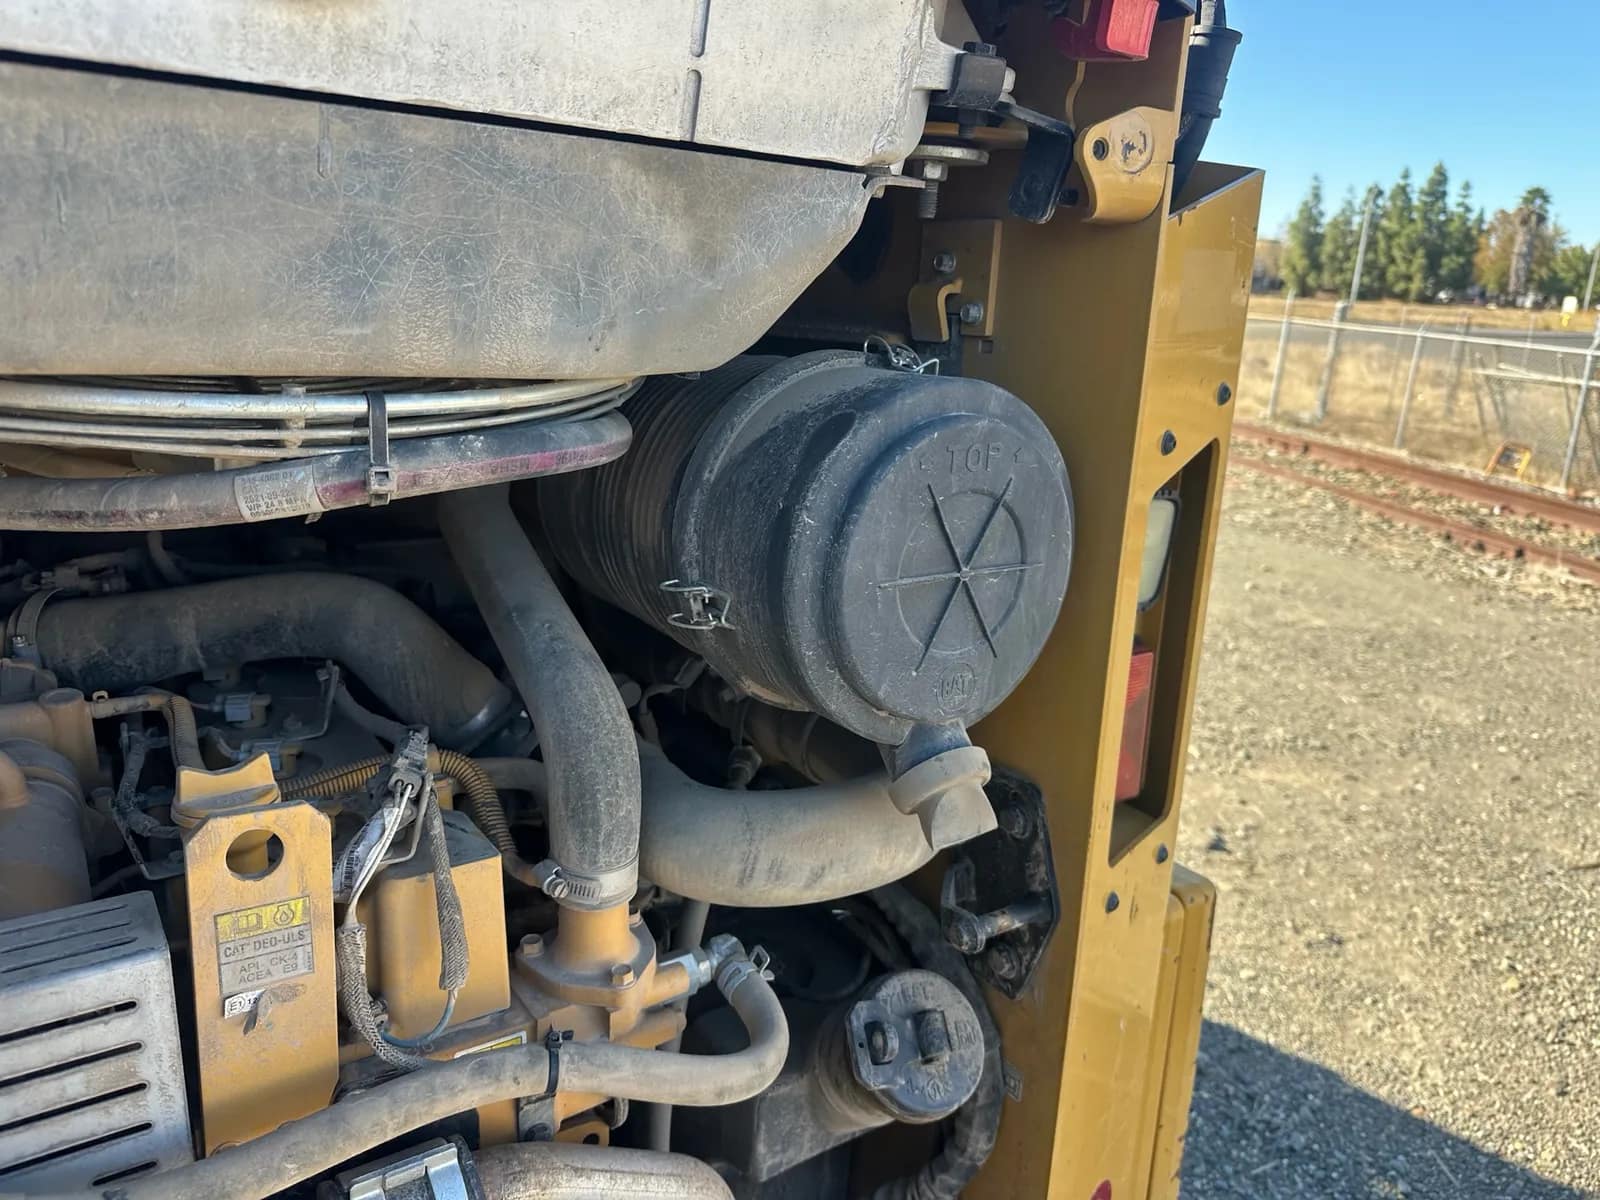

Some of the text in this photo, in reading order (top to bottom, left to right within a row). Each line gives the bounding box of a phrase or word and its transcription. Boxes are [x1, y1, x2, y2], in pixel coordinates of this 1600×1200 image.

[945, 441, 1001, 473] TOP
[239, 963, 298, 985] ACEA E9
